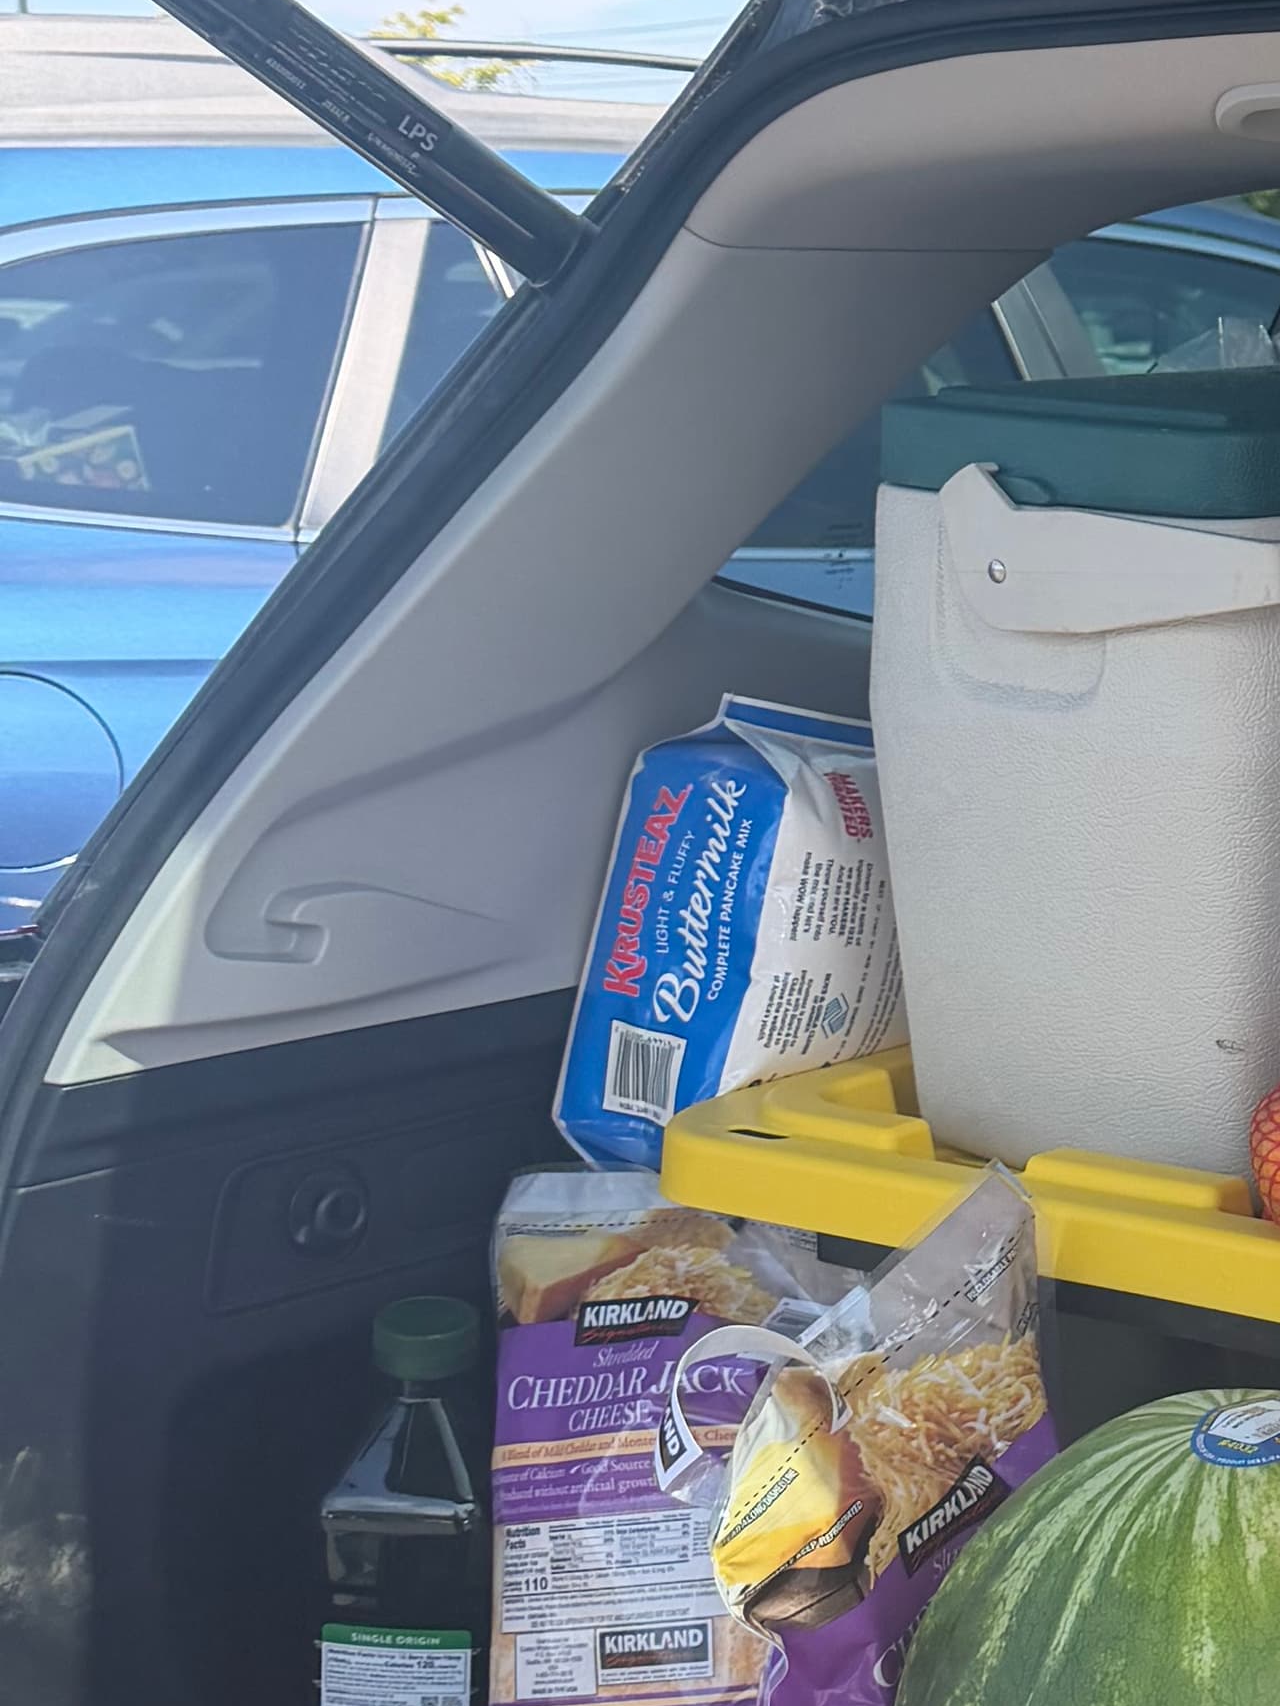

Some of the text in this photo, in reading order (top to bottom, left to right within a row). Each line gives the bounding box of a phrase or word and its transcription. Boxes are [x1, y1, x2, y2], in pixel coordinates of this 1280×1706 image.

[398, 115, 438, 151] LPS
[653, 780, 746, 1023] Buttermilk
[656, 831, 695, 954] LIGHT & FLUFFY
[707, 819, 752, 1001] COMPLETE PANCAKE MIX
[583, 1299, 689, 1328] KIRKLAND
[593, 1341, 659, 1368] Shredded
[508, 1367, 647, 1410] CHEDDAR
[569, 1400, 653, 1432] CHEESE
[581, 1459, 609, 1474] Good
[610, 1459, 649, 1471] Source
[906, 1465, 994, 1555] KIRKLAND
[524, 1577, 548, 1591] 110
[351, 1632, 441, 1645] SINGLE ORIGIN
[605, 1629, 703, 1654] KIRKLAND
